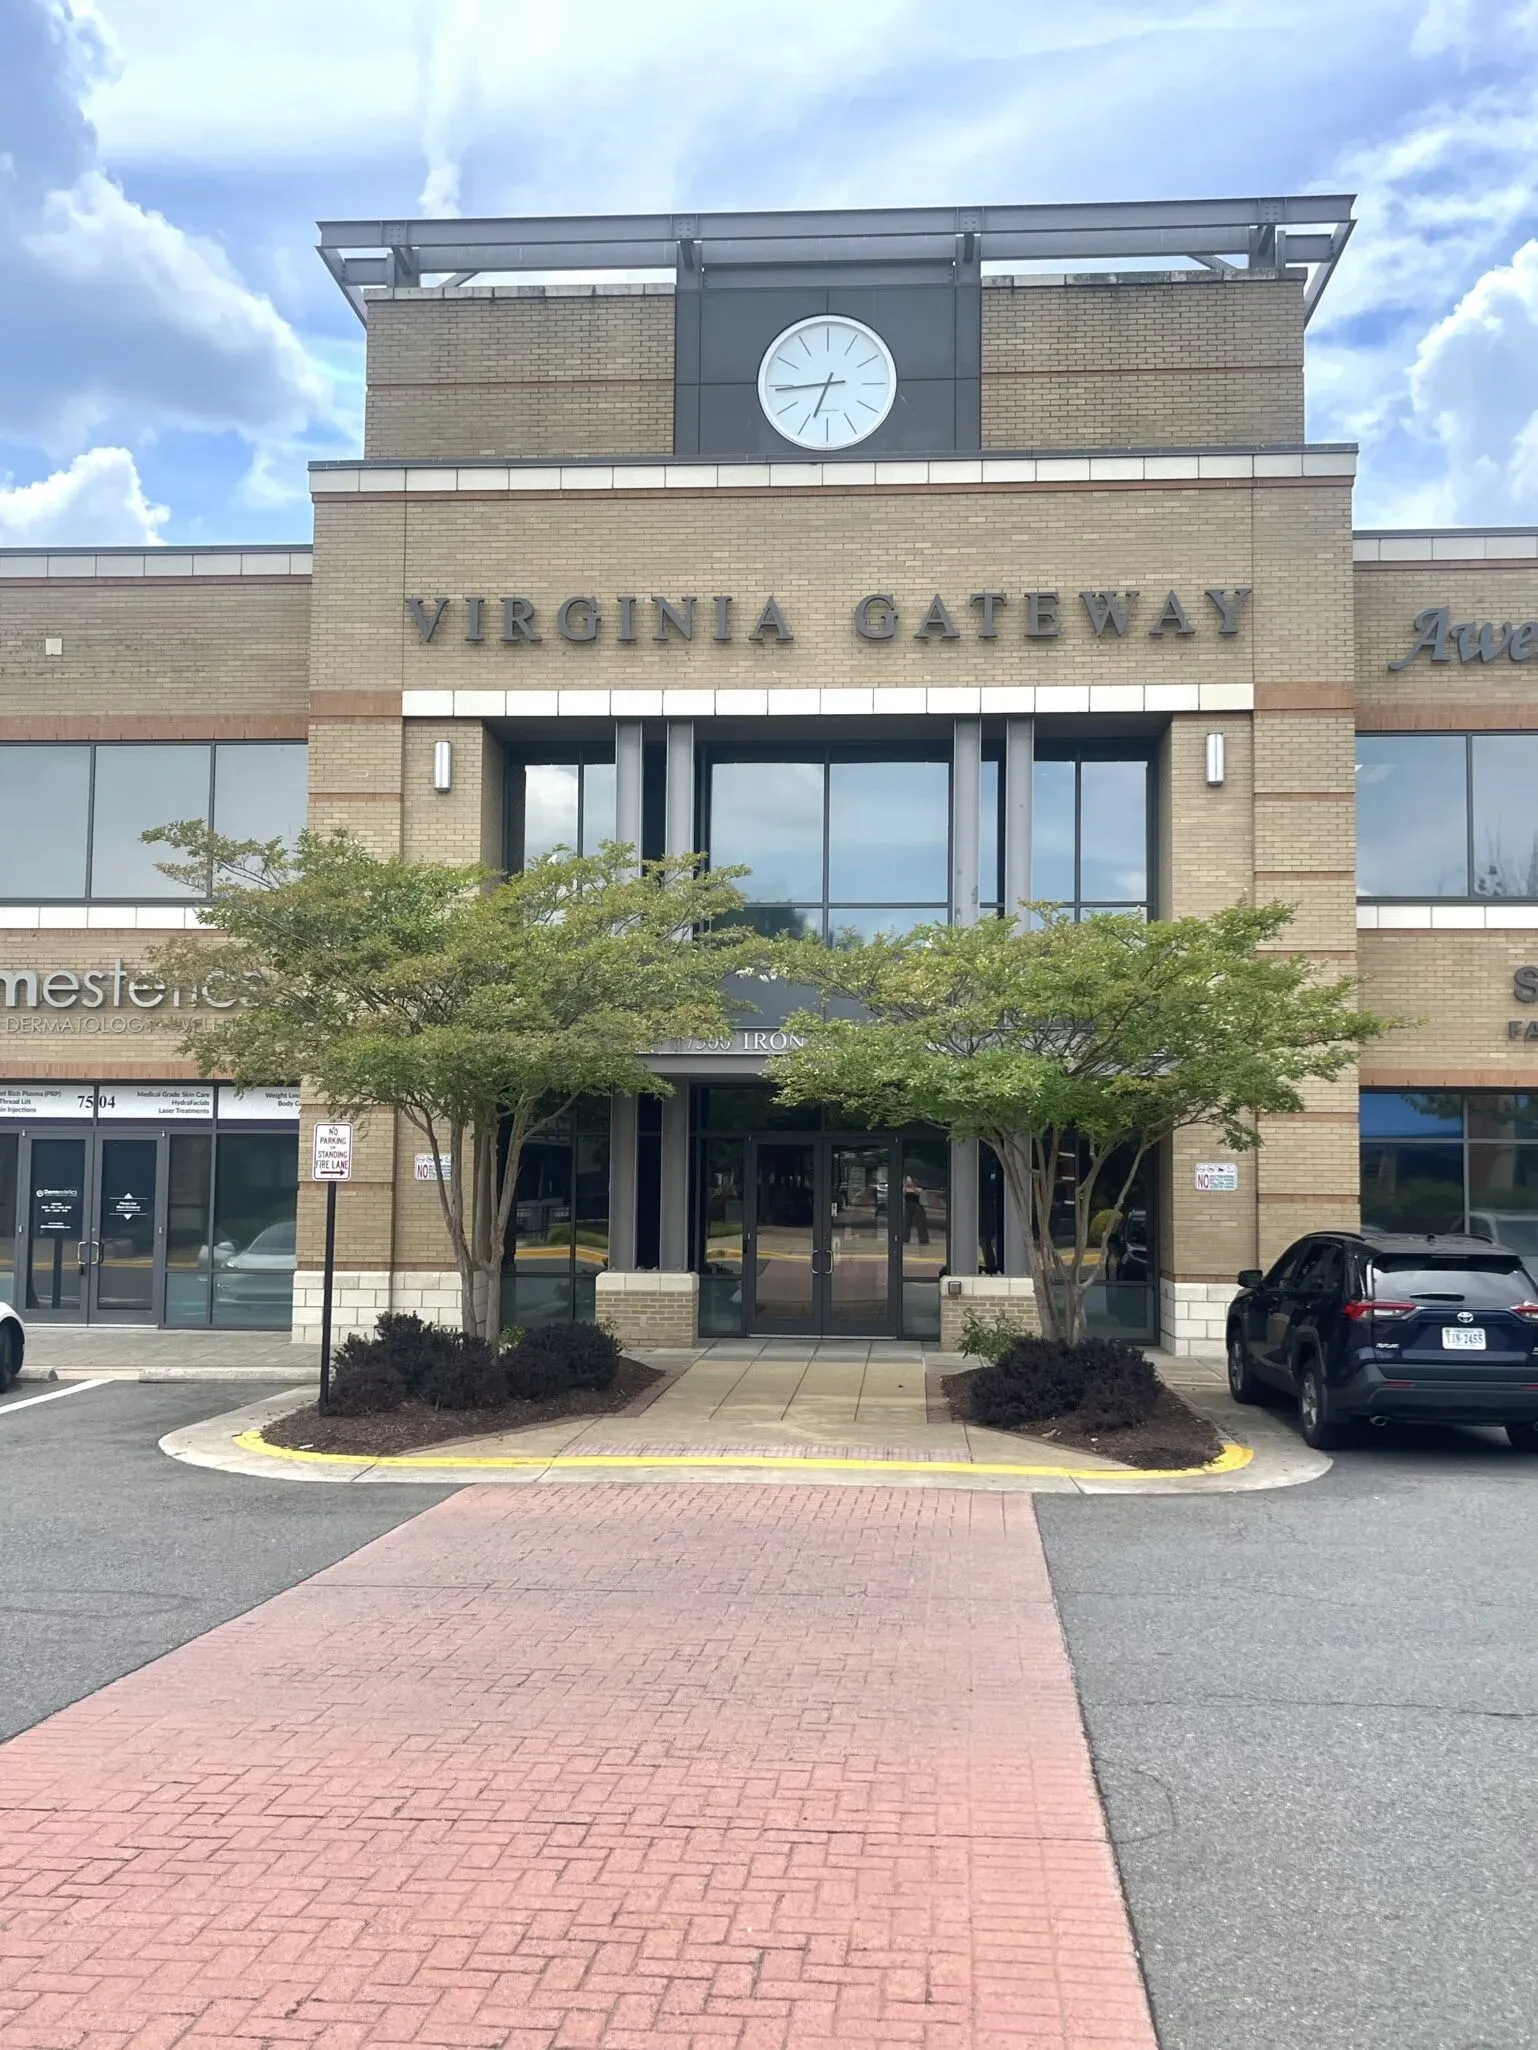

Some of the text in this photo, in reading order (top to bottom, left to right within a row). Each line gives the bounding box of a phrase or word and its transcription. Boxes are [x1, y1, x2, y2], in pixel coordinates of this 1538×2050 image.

[406, 588, 1253, 643] VIRGINIA GATEWAY
[1388, 604, 1538, 671] Awe
[6, 1016, 156, 1034] DERMATOLOG
[328, 1128, 338, 1136] NO
[320, 1136, 346, 1145] PARKING
[318, 1150, 347, 1159] STANDING
[315, 1160, 348, 1170] FIRE LANE
[417, 1164, 429, 1178] NO
[1197, 1174, 1210, 1189] NO
